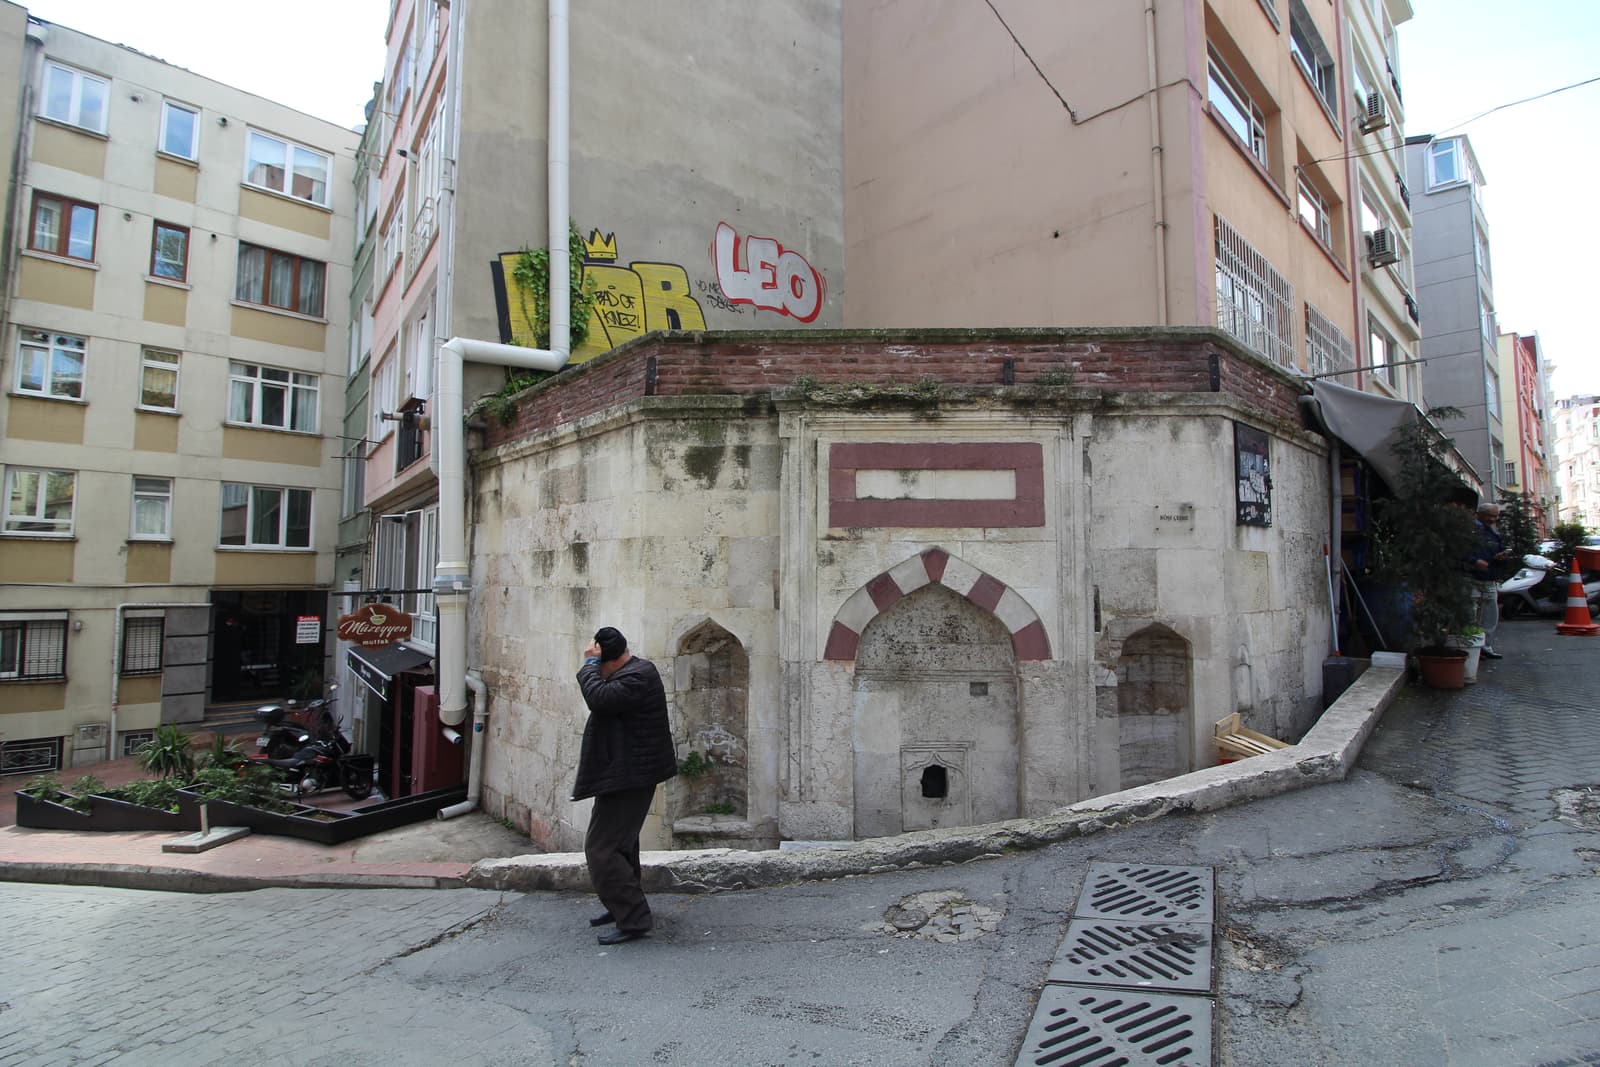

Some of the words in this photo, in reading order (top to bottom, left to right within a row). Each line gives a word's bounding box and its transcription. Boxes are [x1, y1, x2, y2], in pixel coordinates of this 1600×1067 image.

[714, 220, 823, 323] LEO
[619, 294, 636, 309] OF
[339, 619, 408, 638] Müzeyyen
